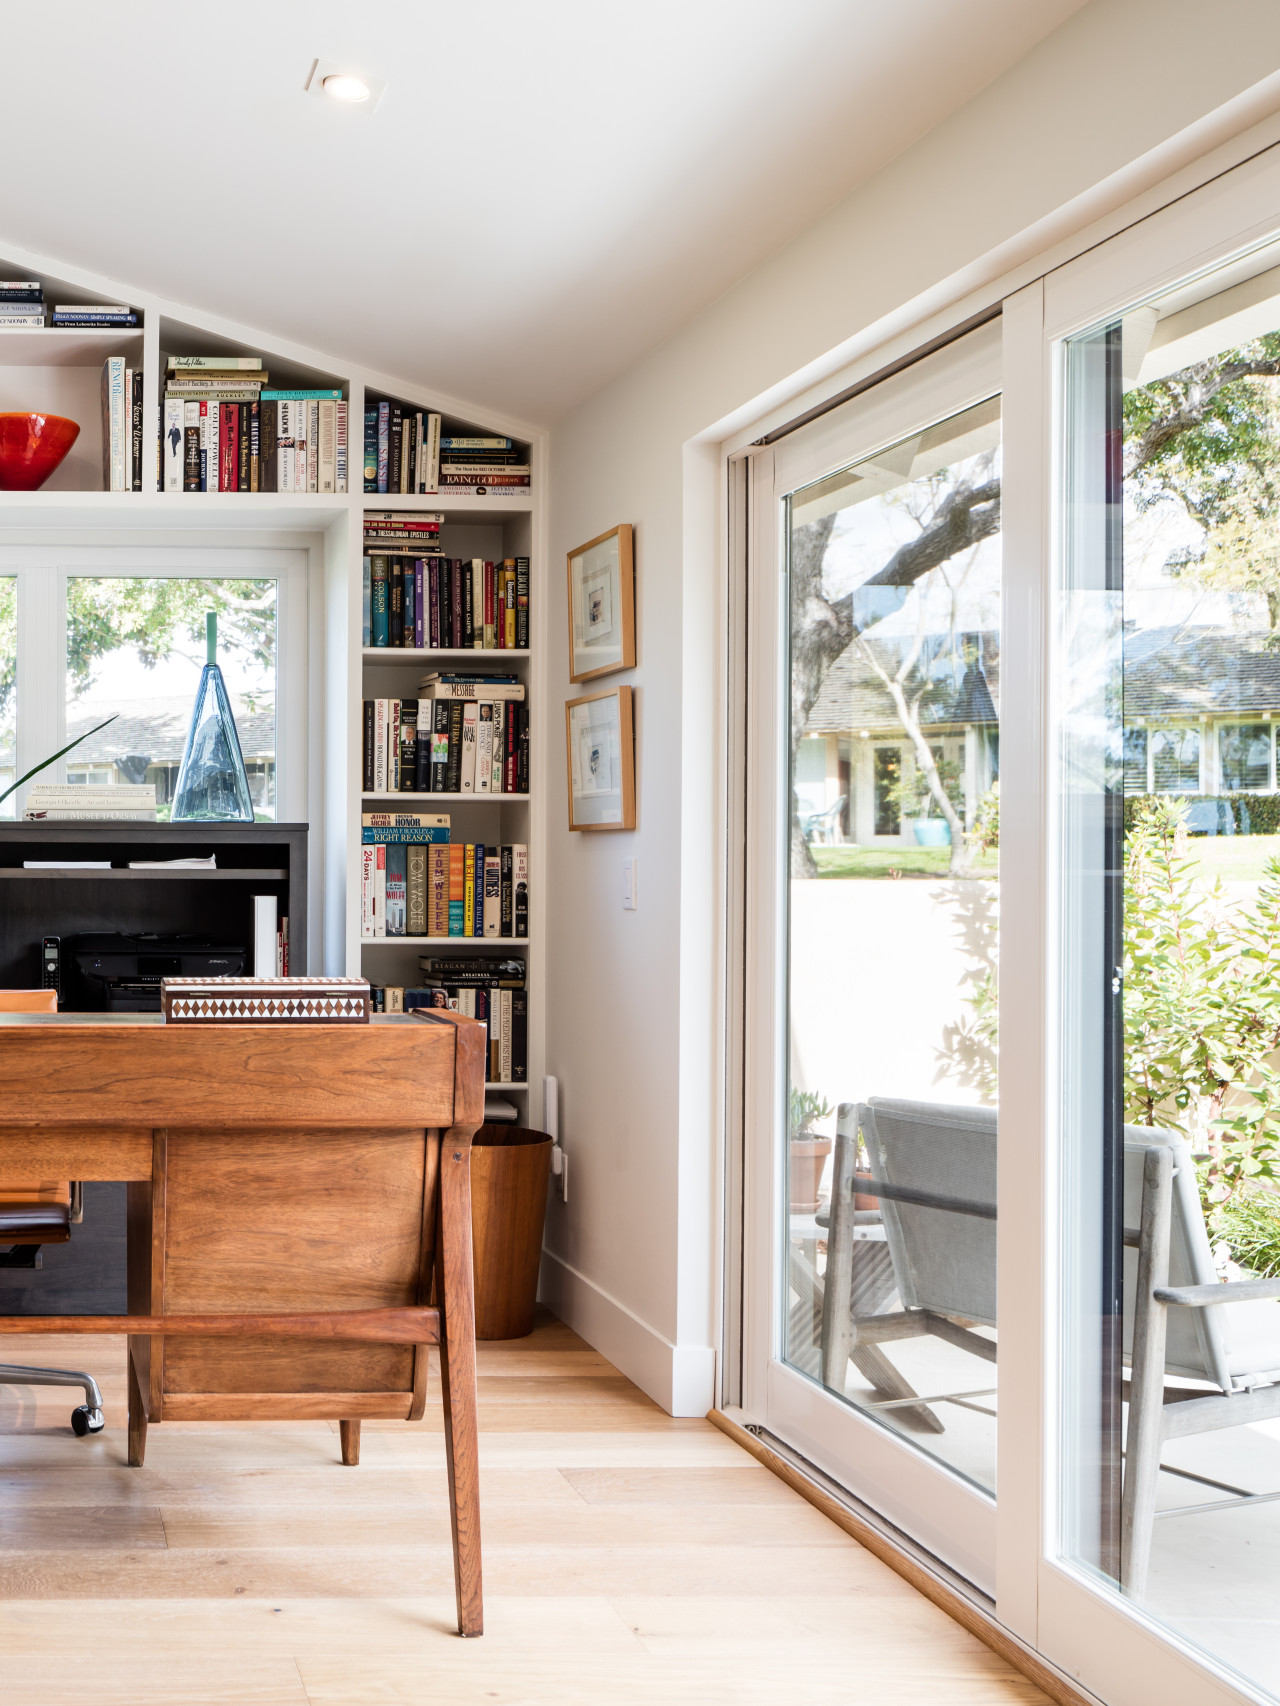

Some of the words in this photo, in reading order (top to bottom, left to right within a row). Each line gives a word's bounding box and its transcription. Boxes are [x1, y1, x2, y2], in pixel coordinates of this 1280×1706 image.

[112, 361, 122, 395] RENOIR
[133, 402, 142, 425] Texas
[380, 412, 389, 436] BEN
[133, 426, 142, 457] Women
[251, 422, 259, 455] MAESTRO
[378, 448, 388, 486] SASSE
[518, 558, 528, 575] THE
[507, 581, 515, 609] Revelation
[518, 575, 528, 596] BODY
[452, 684, 475, 697] MESSAGE
[453, 705, 461, 721] THE
[452, 724, 460, 744] FIRM
[401, 834, 433, 842] REASON
[363, 851, 373, 861] 24
[434, 849, 444, 876] TOM
[390, 873, 402, 882] TOM
[410, 854, 424, 884] TOM
[485, 868, 499, 897] WITNESS
[386, 891, 405, 899] WOLFE
[434, 882, 444, 930] WOLFE
[410, 889, 424, 925] WOLFE
[503, 1055, 511, 1072] BALL
